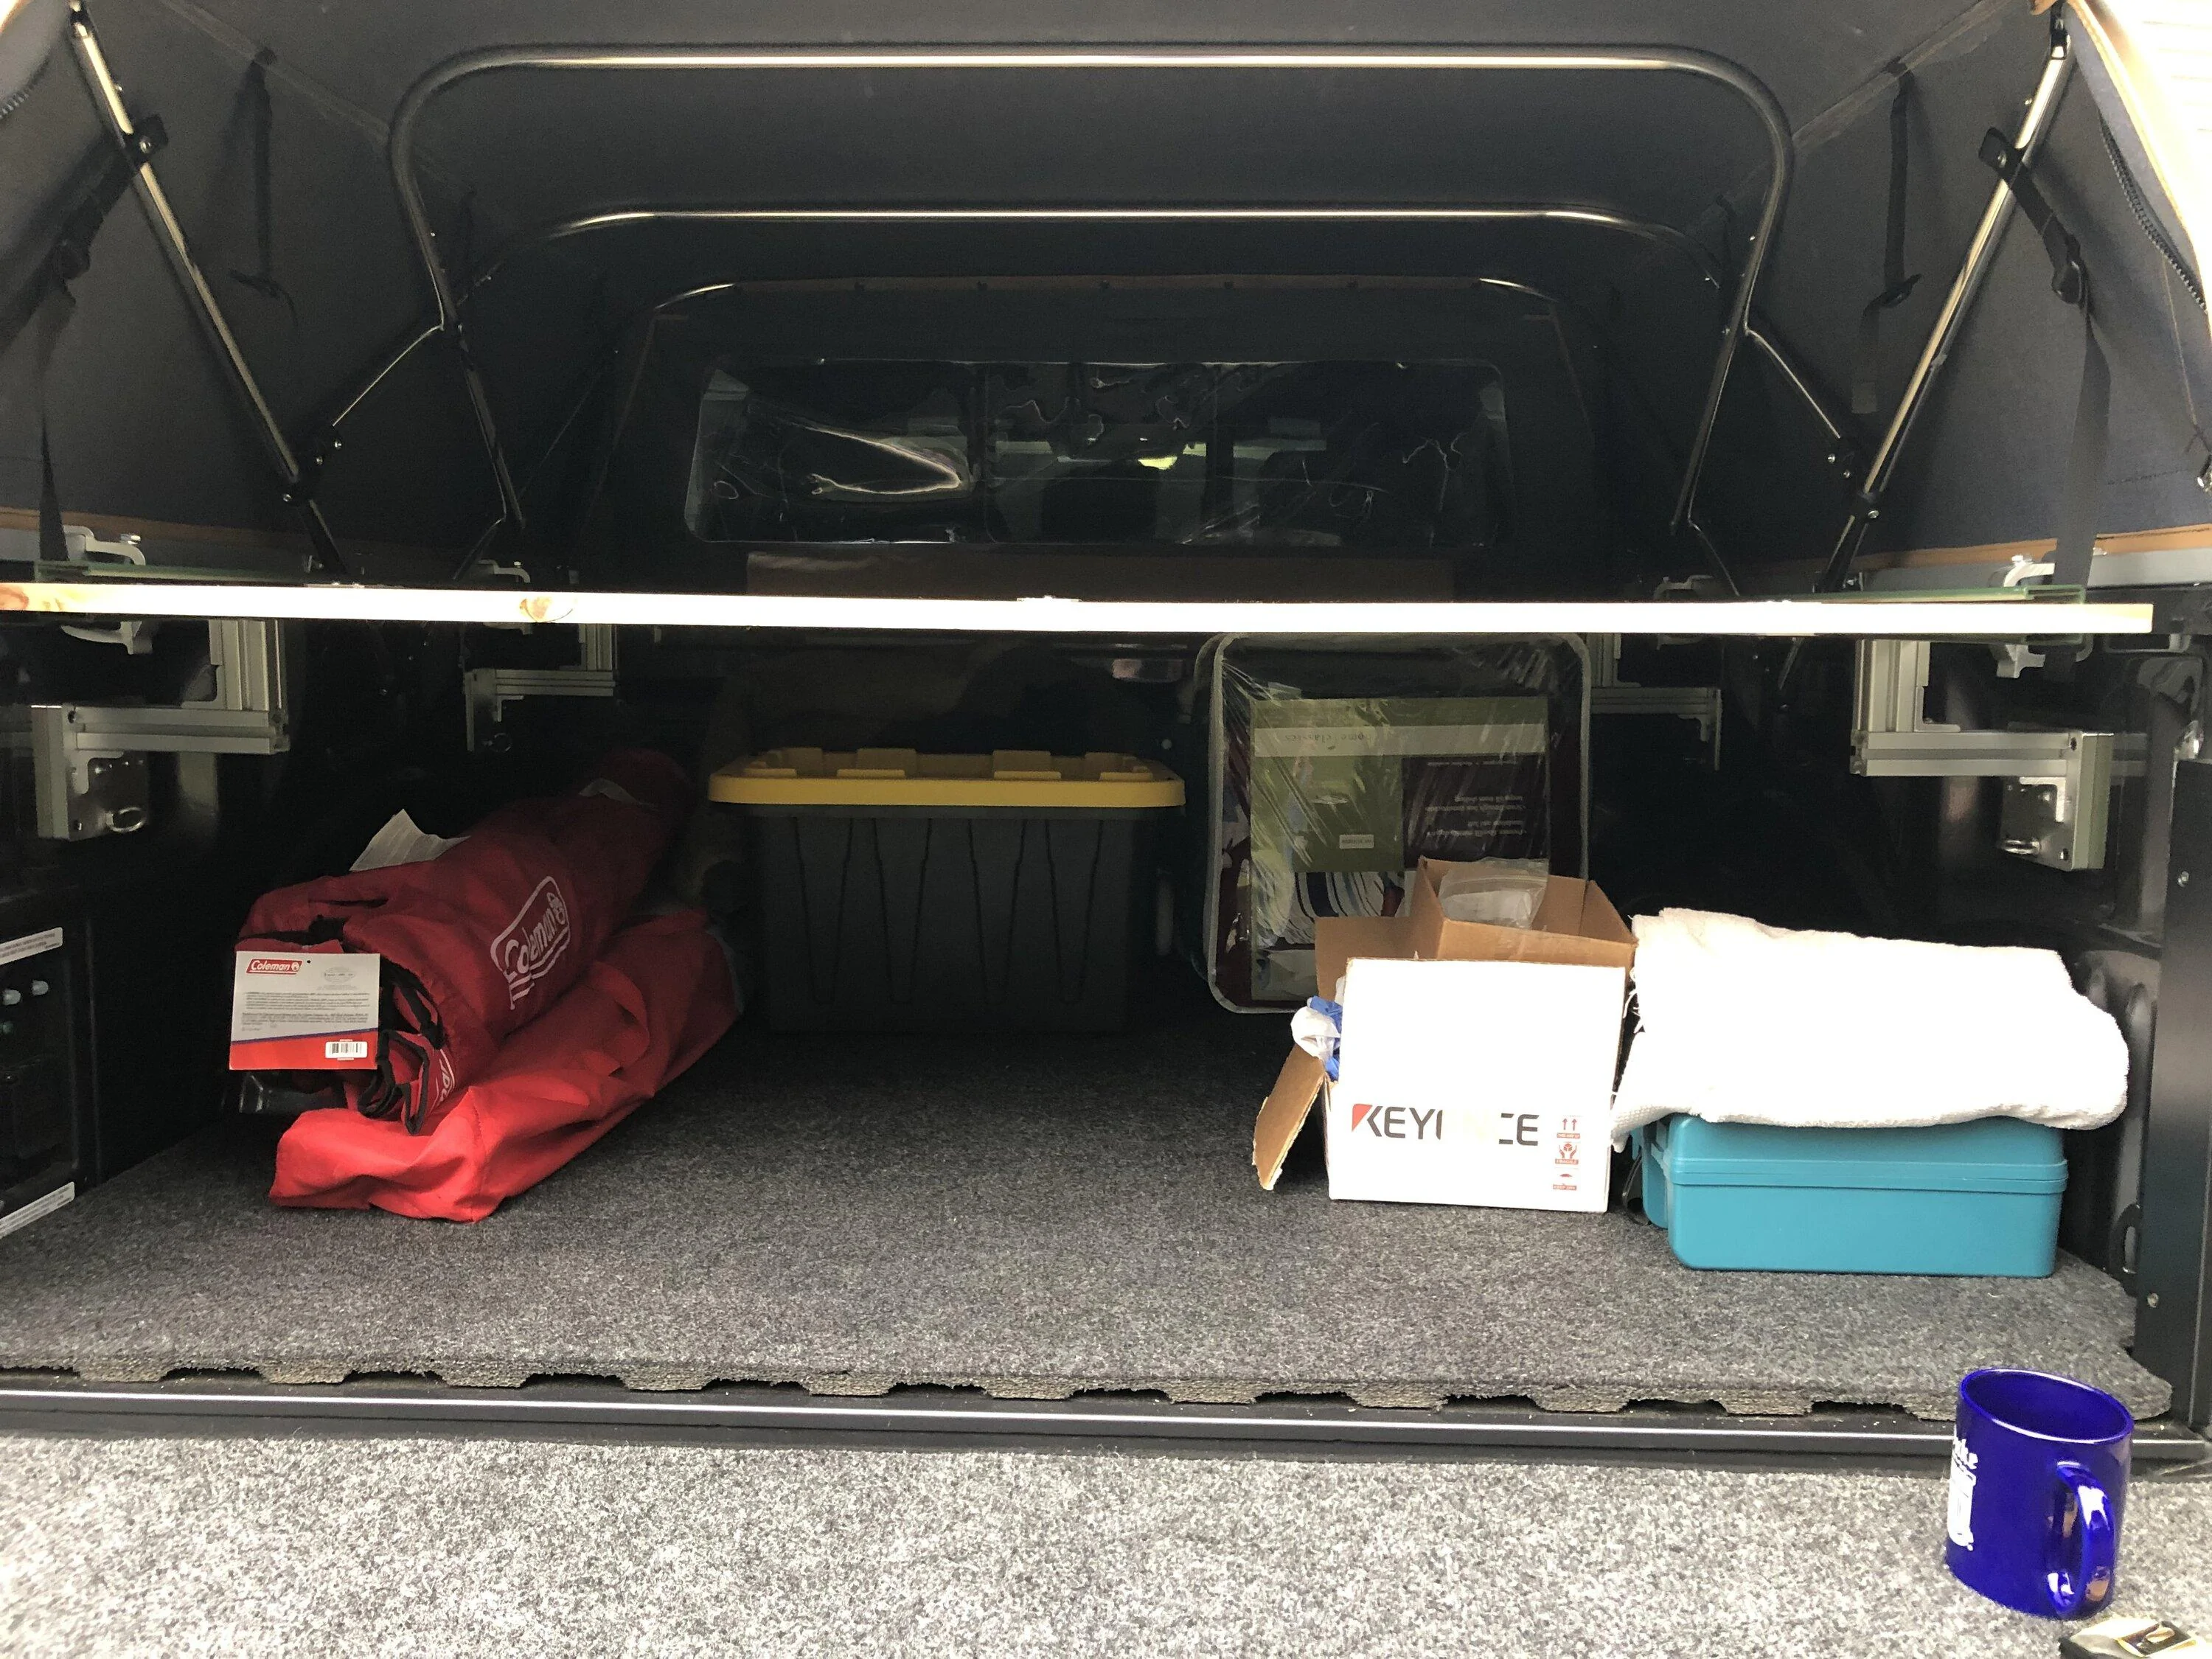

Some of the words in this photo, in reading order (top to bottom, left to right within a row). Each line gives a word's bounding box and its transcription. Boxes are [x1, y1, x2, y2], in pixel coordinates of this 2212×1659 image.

[251, 959, 292, 972] Coleman
[503, 907, 558, 983] Coleman
[1351, 1103, 1540, 1147] KEYE
